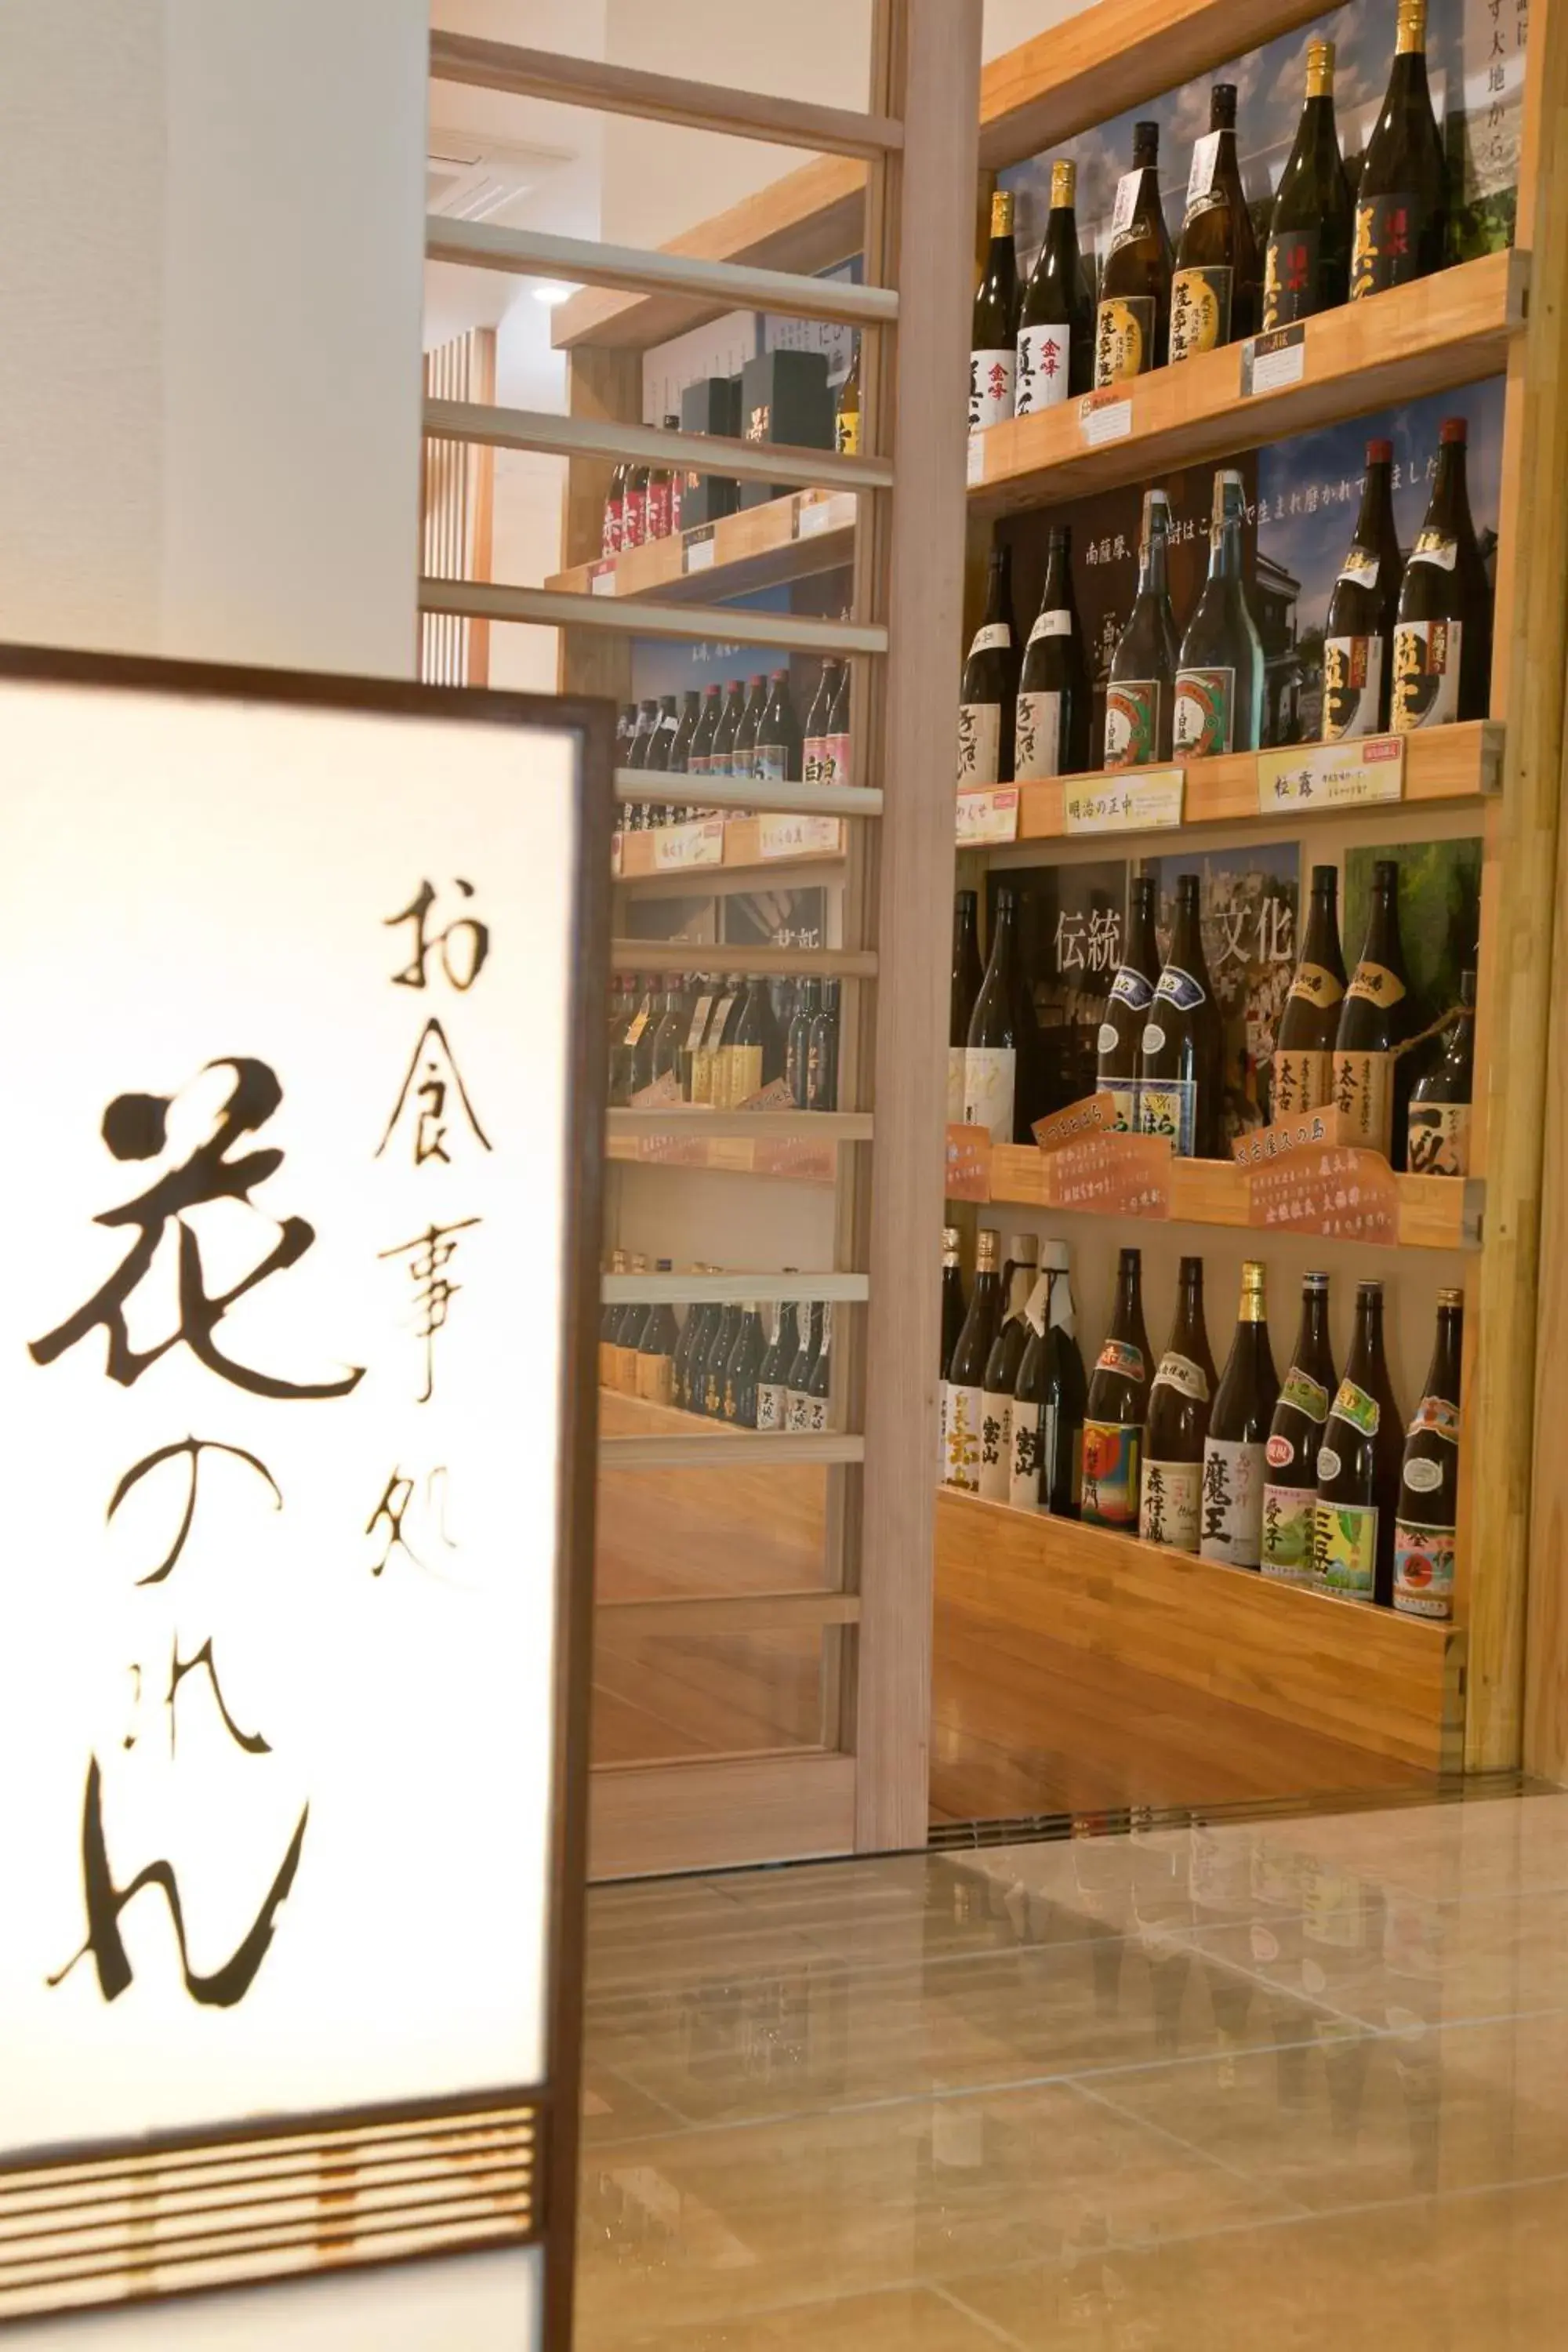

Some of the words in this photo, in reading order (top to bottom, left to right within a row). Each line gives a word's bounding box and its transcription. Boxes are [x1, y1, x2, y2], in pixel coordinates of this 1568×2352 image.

[1054, 907, 1121, 974] 伝統
[1215, 897, 1294, 966] 文化
[1279, 1058, 1298, 1111] 太古
[1339, 1059, 1359, 1114] 太古
[365, 877, 492, 1582] お食事処
[982, 1415, 1001, 1465] 宝山
[1015, 1426, 1039, 1478] 宝山
[1202, 1452, 1232, 1544] 魔王
[28, 1056, 367, 2008] 花のれん
